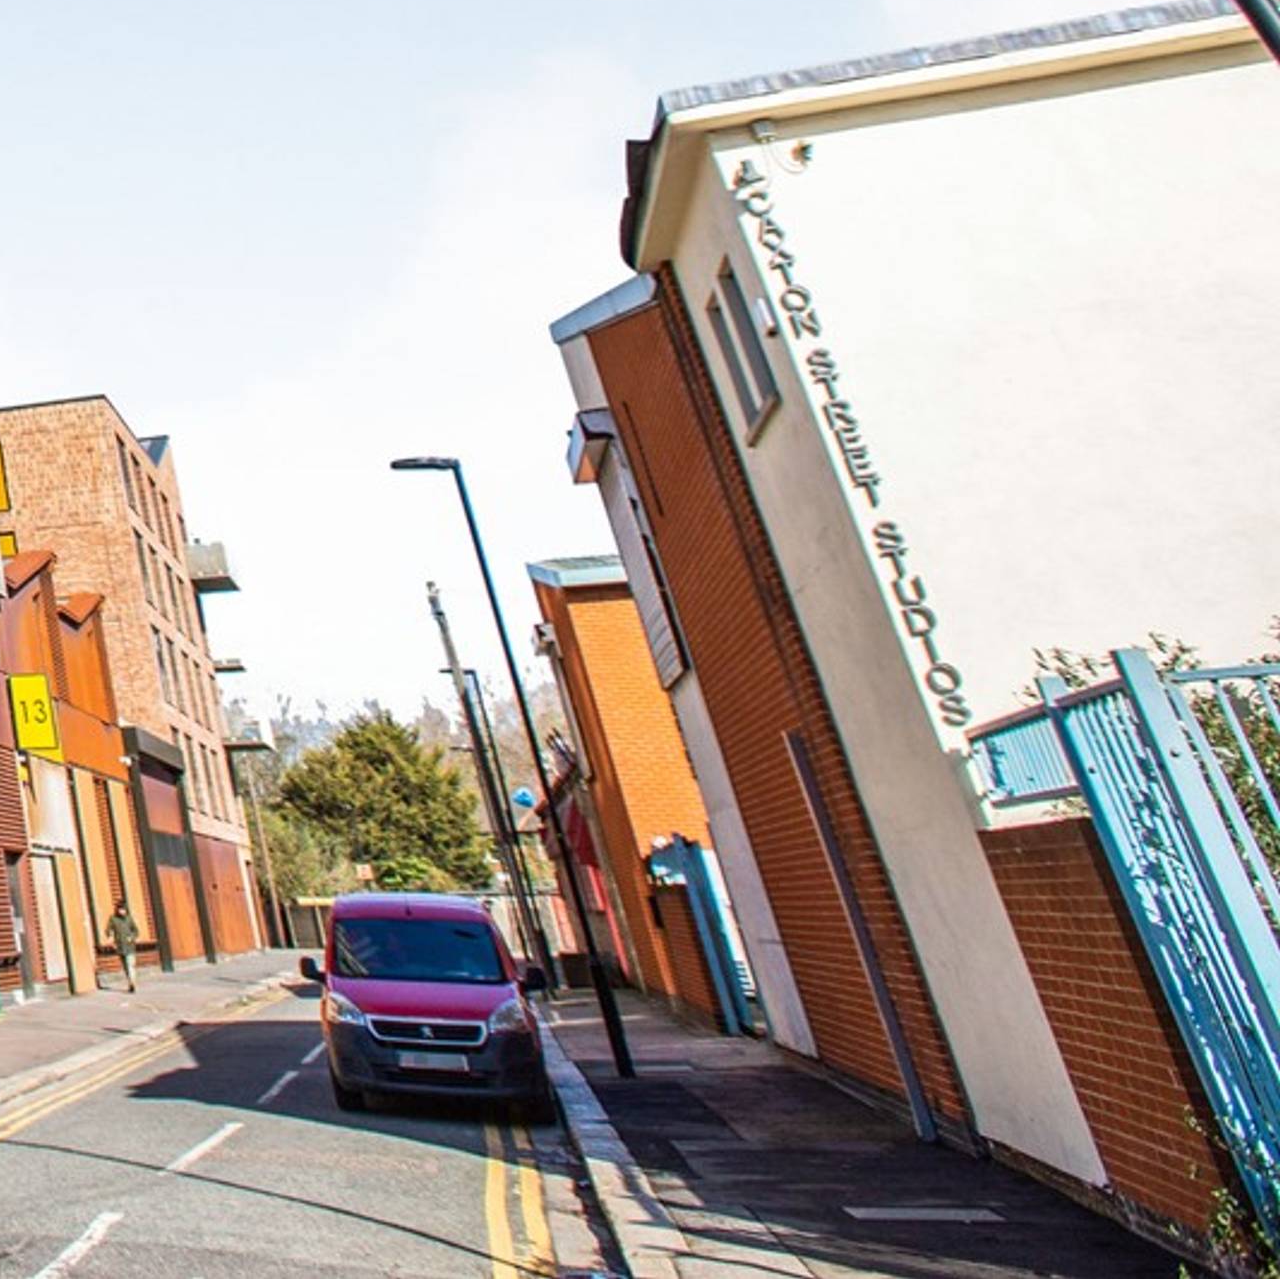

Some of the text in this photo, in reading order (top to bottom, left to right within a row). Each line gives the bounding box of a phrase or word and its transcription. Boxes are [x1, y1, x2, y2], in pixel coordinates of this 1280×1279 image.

[744, 190, 823, 340] CAXTON
[806, 348, 882, 509] STREET
[872, 520, 972, 728] STUDIOS
[19, 698, 48, 724] 13
